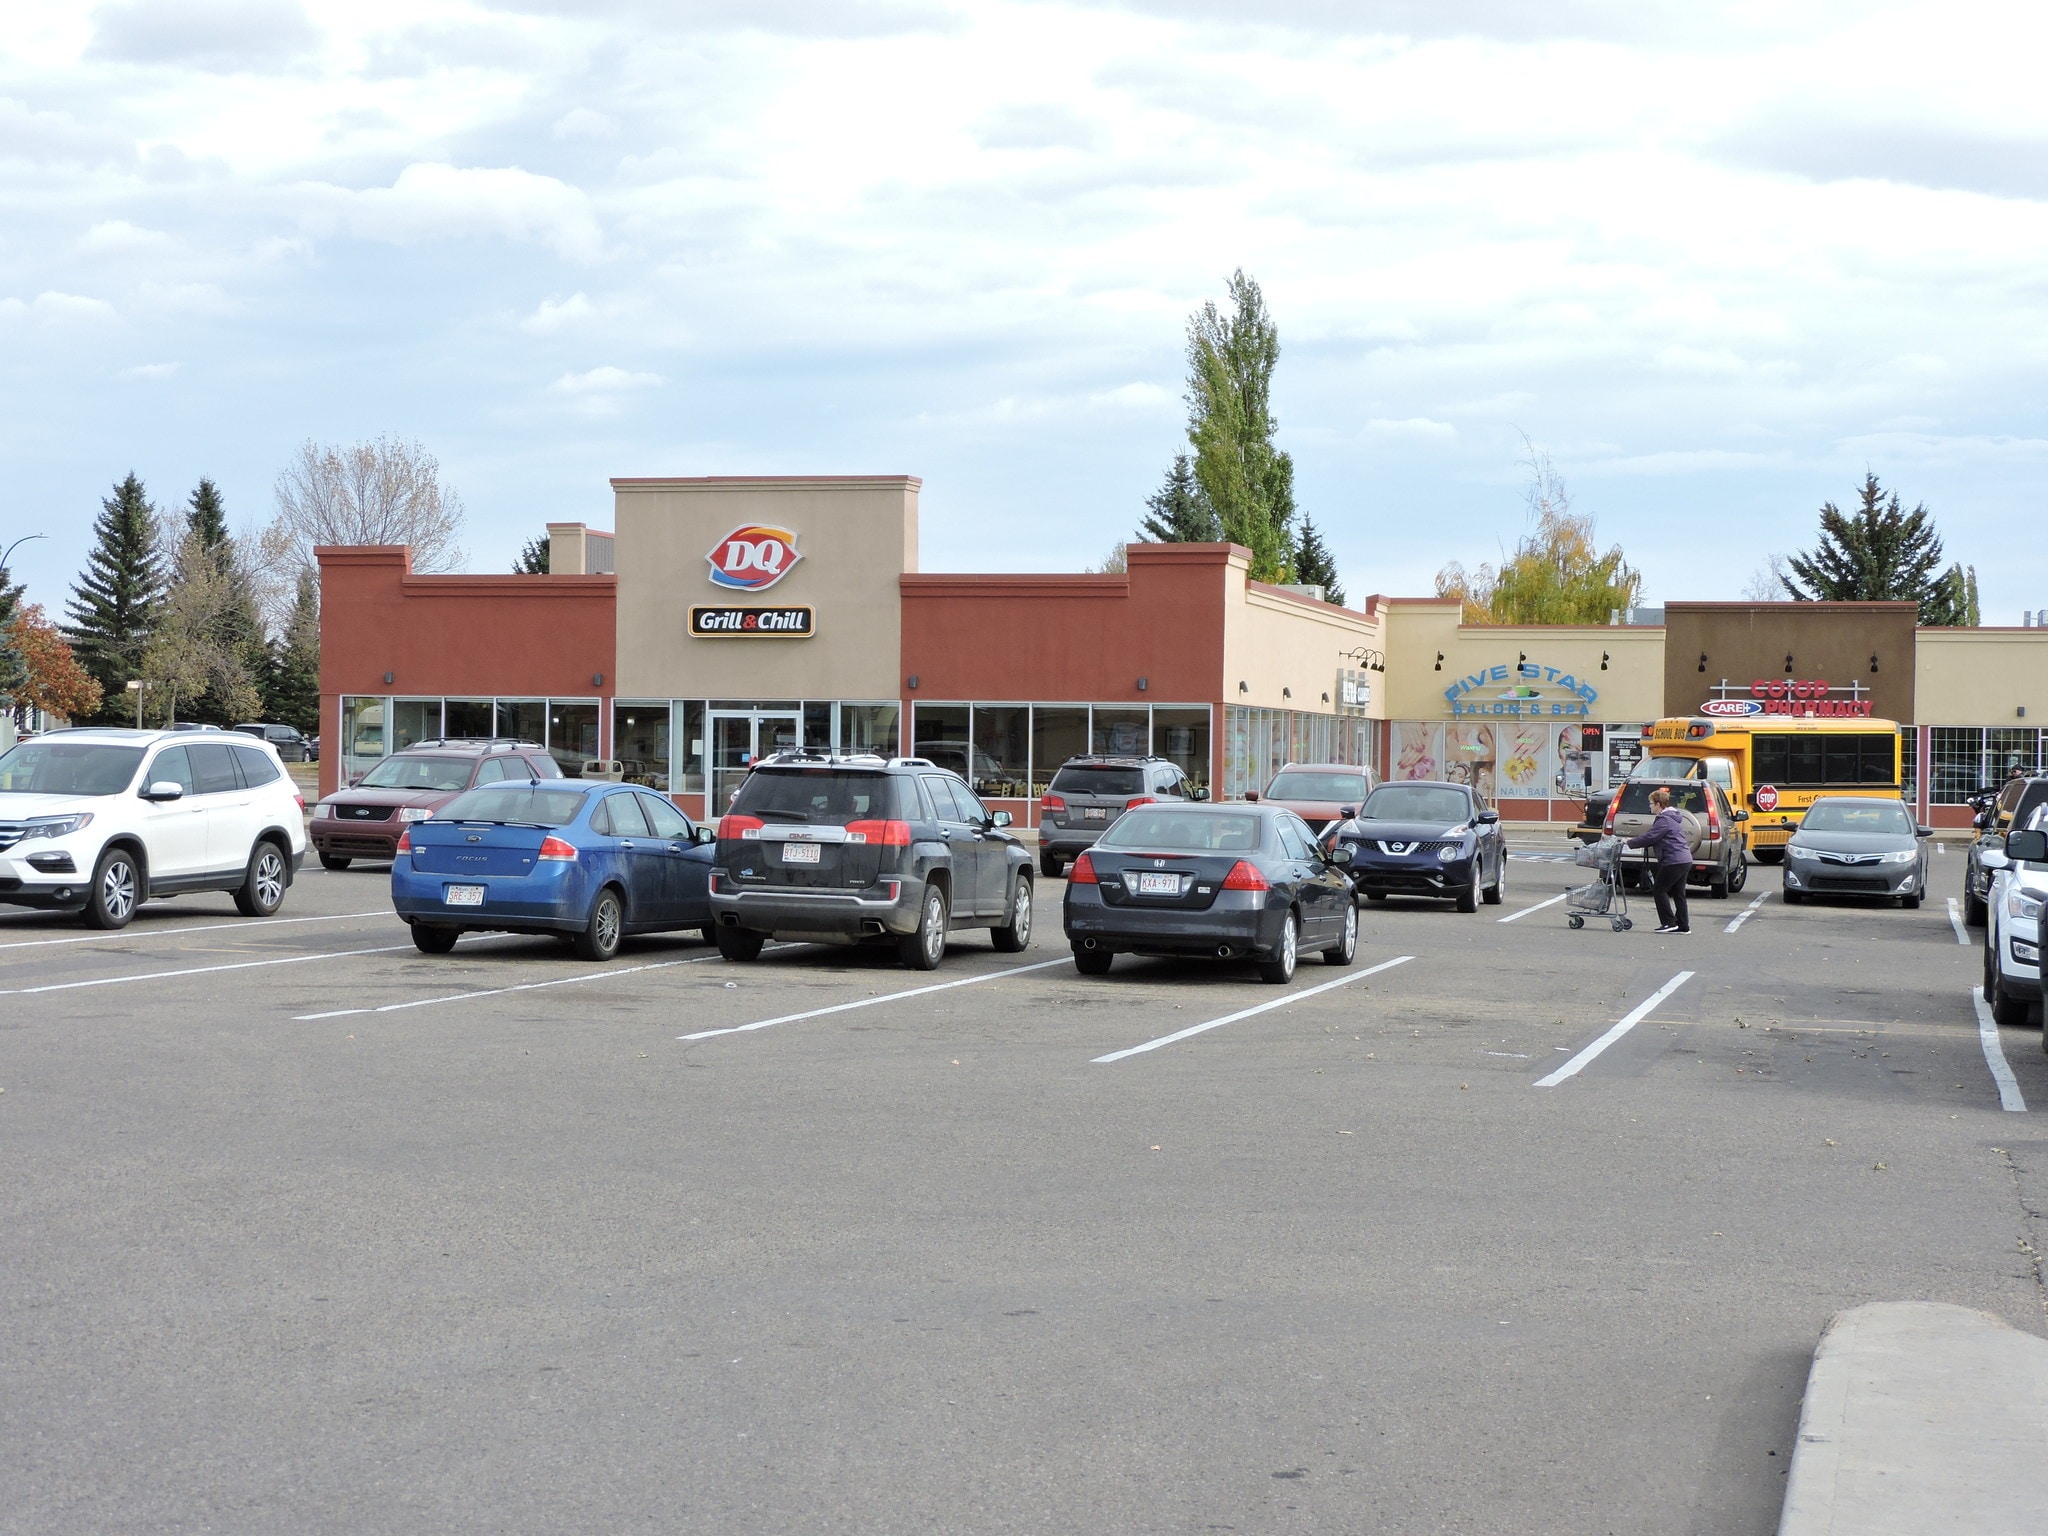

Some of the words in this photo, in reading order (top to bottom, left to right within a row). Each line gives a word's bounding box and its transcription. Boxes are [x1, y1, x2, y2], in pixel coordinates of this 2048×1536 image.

[724, 539, 784, 574] DQ
[1444, 664, 1509, 703] FIVE
[1520, 663, 1599, 705] STAR
[1452, 703, 1521, 715] SALON
[1530, 703, 1541, 715] &
[1551, 703, 1590, 715] SPA
[1764, 700, 1874, 718] PHARMACY
[1582, 727, 1600, 736] OPEN
[1654, 728, 1673, 739] SCHOOL
[1674, 728, 1686, 739] BUS
[1500, 787, 1524, 796] NAIL
[1527, 787, 1548, 797] BAR
[1760, 793, 1776, 804] STOP
[1797, 795, 1812, 803] First
[789, 832, 813, 840] GMC
